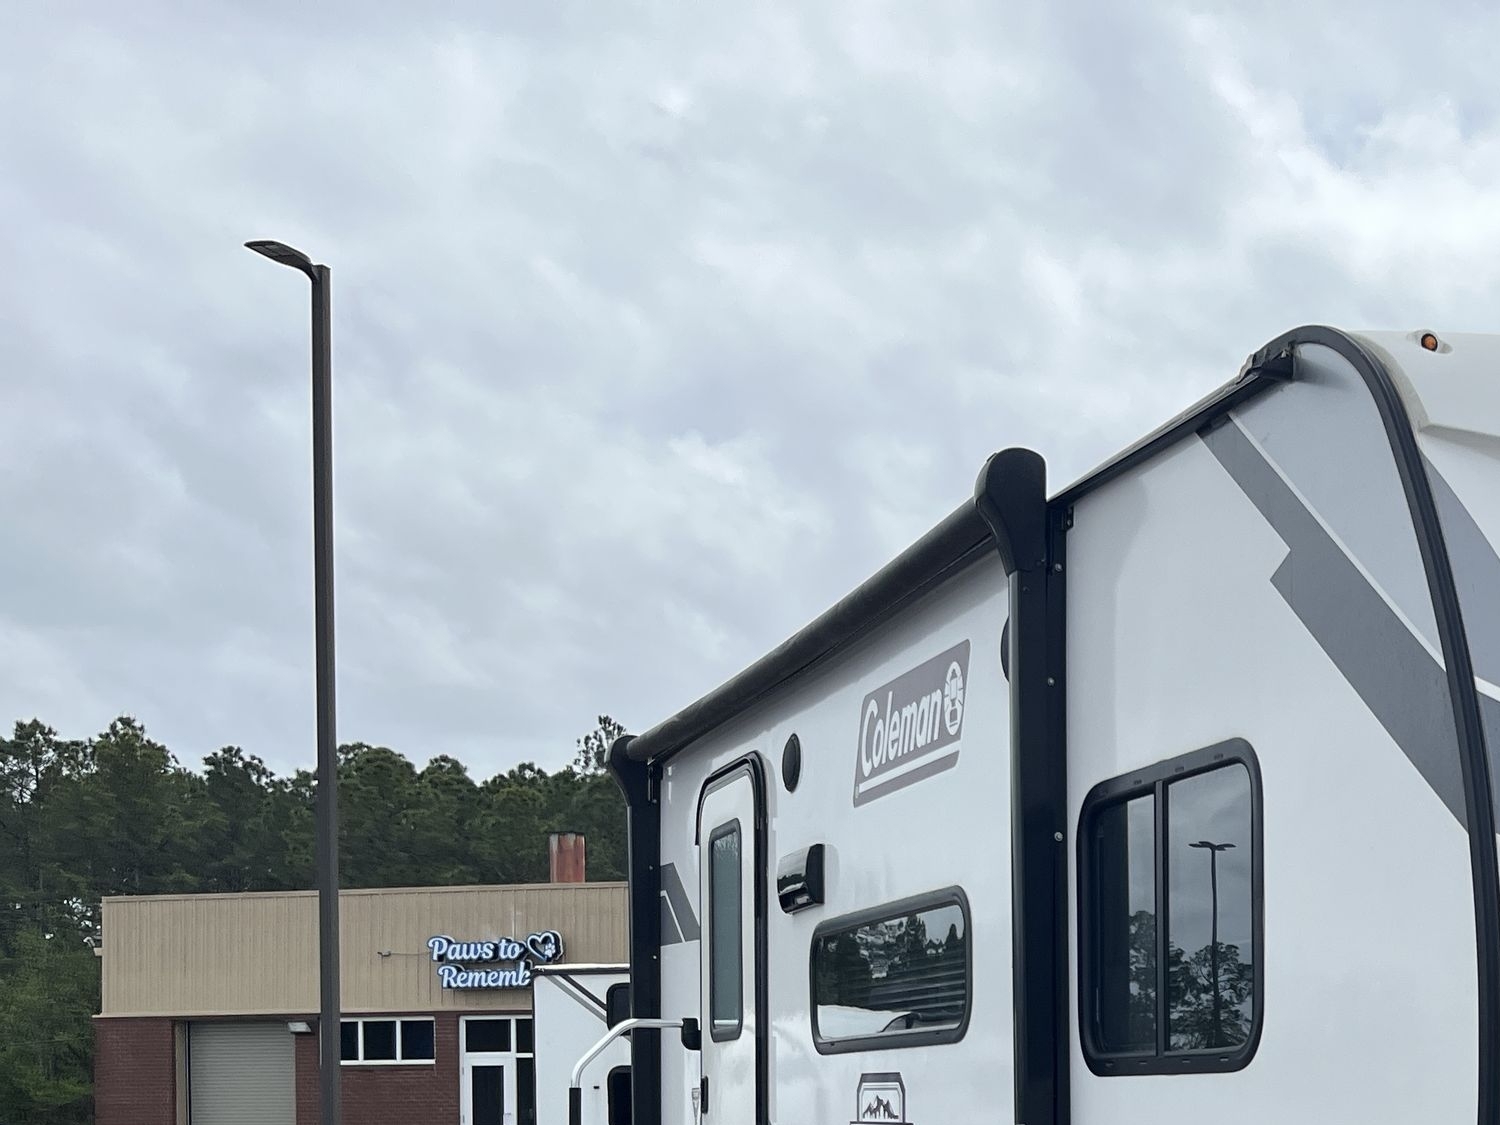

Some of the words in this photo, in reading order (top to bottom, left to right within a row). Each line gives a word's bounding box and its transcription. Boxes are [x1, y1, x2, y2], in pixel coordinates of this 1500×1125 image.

[862, 691, 942, 777] Coleman
[428, 937, 495, 961] Paws
[498, 939, 525, 959] to
